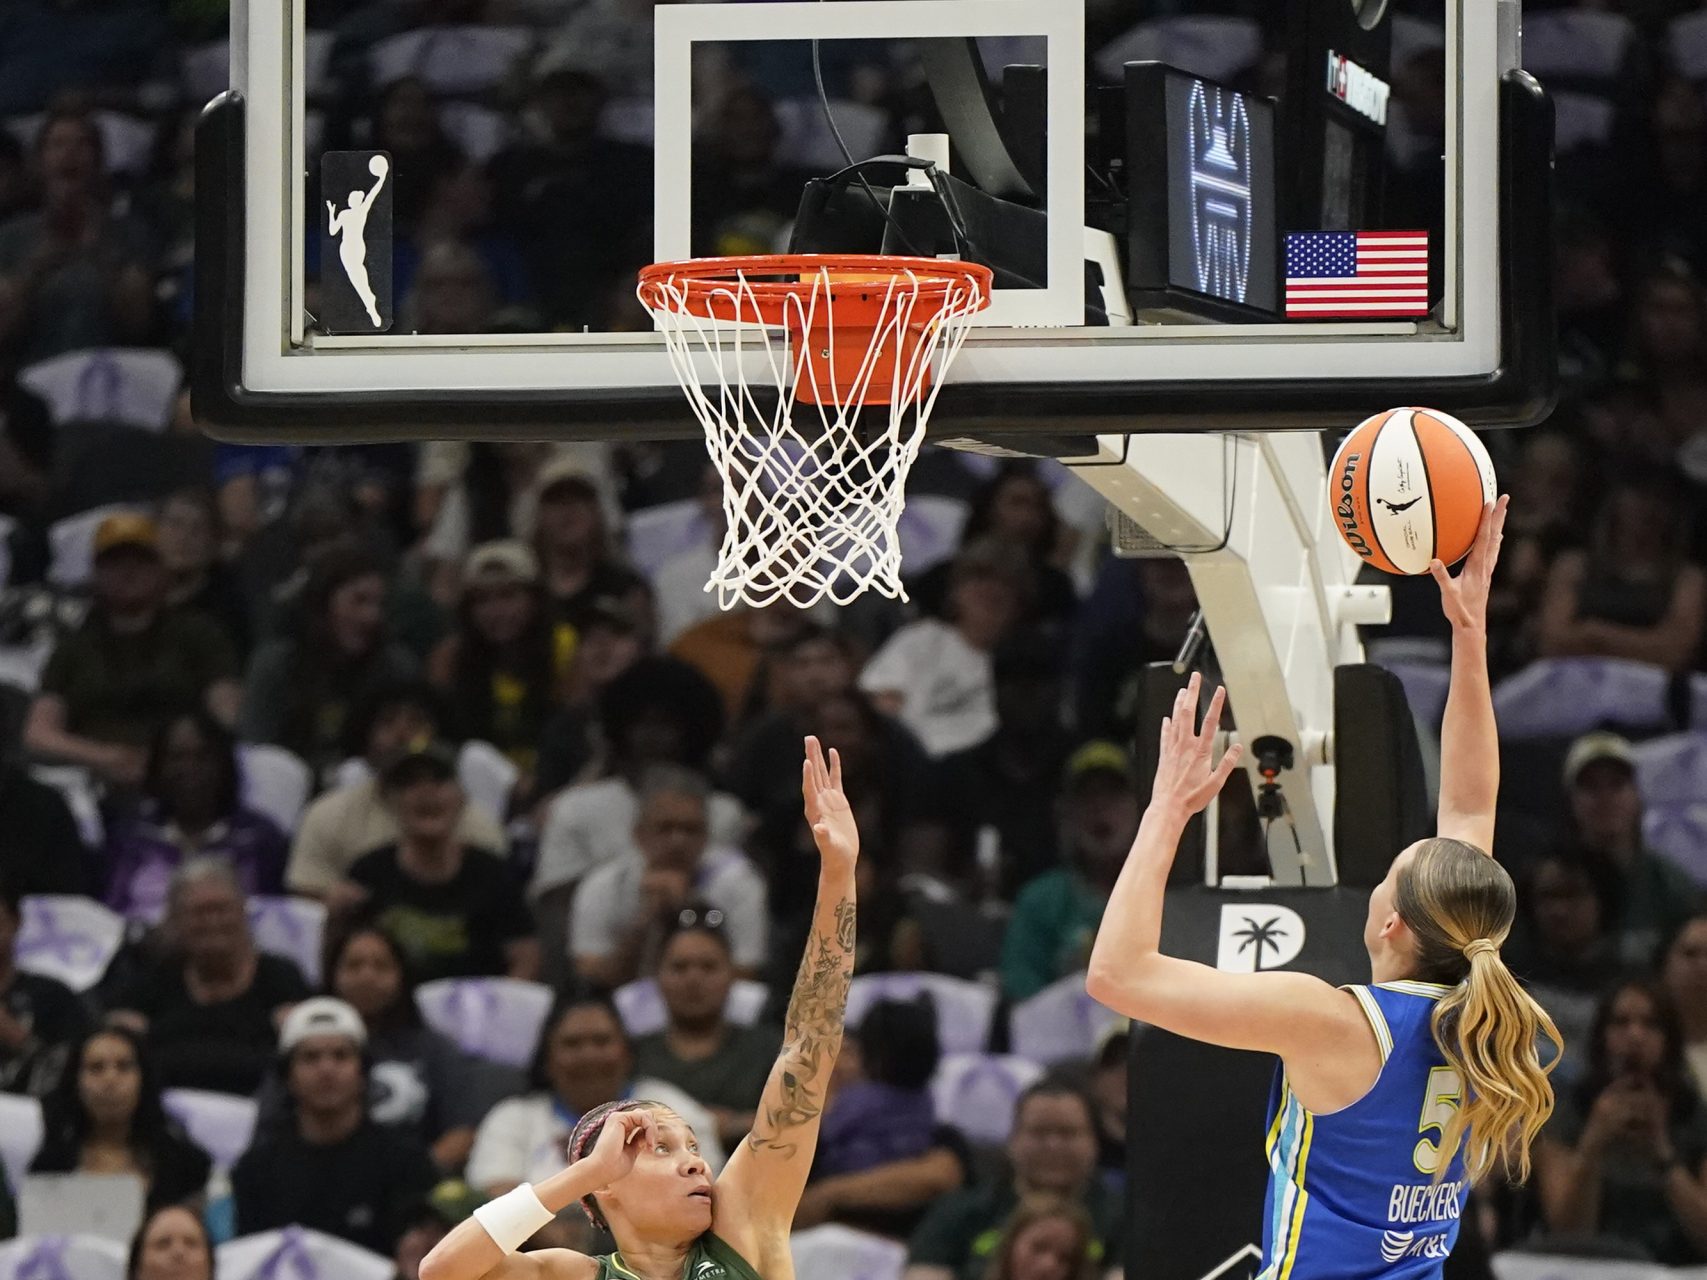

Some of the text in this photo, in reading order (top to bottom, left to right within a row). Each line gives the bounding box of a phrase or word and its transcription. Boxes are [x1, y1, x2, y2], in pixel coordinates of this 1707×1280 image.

[1337, 452, 1374, 558] Wilson
[1413, 1066, 1463, 1175] 5
[1388, 1181, 1463, 1224] BUECKERS
